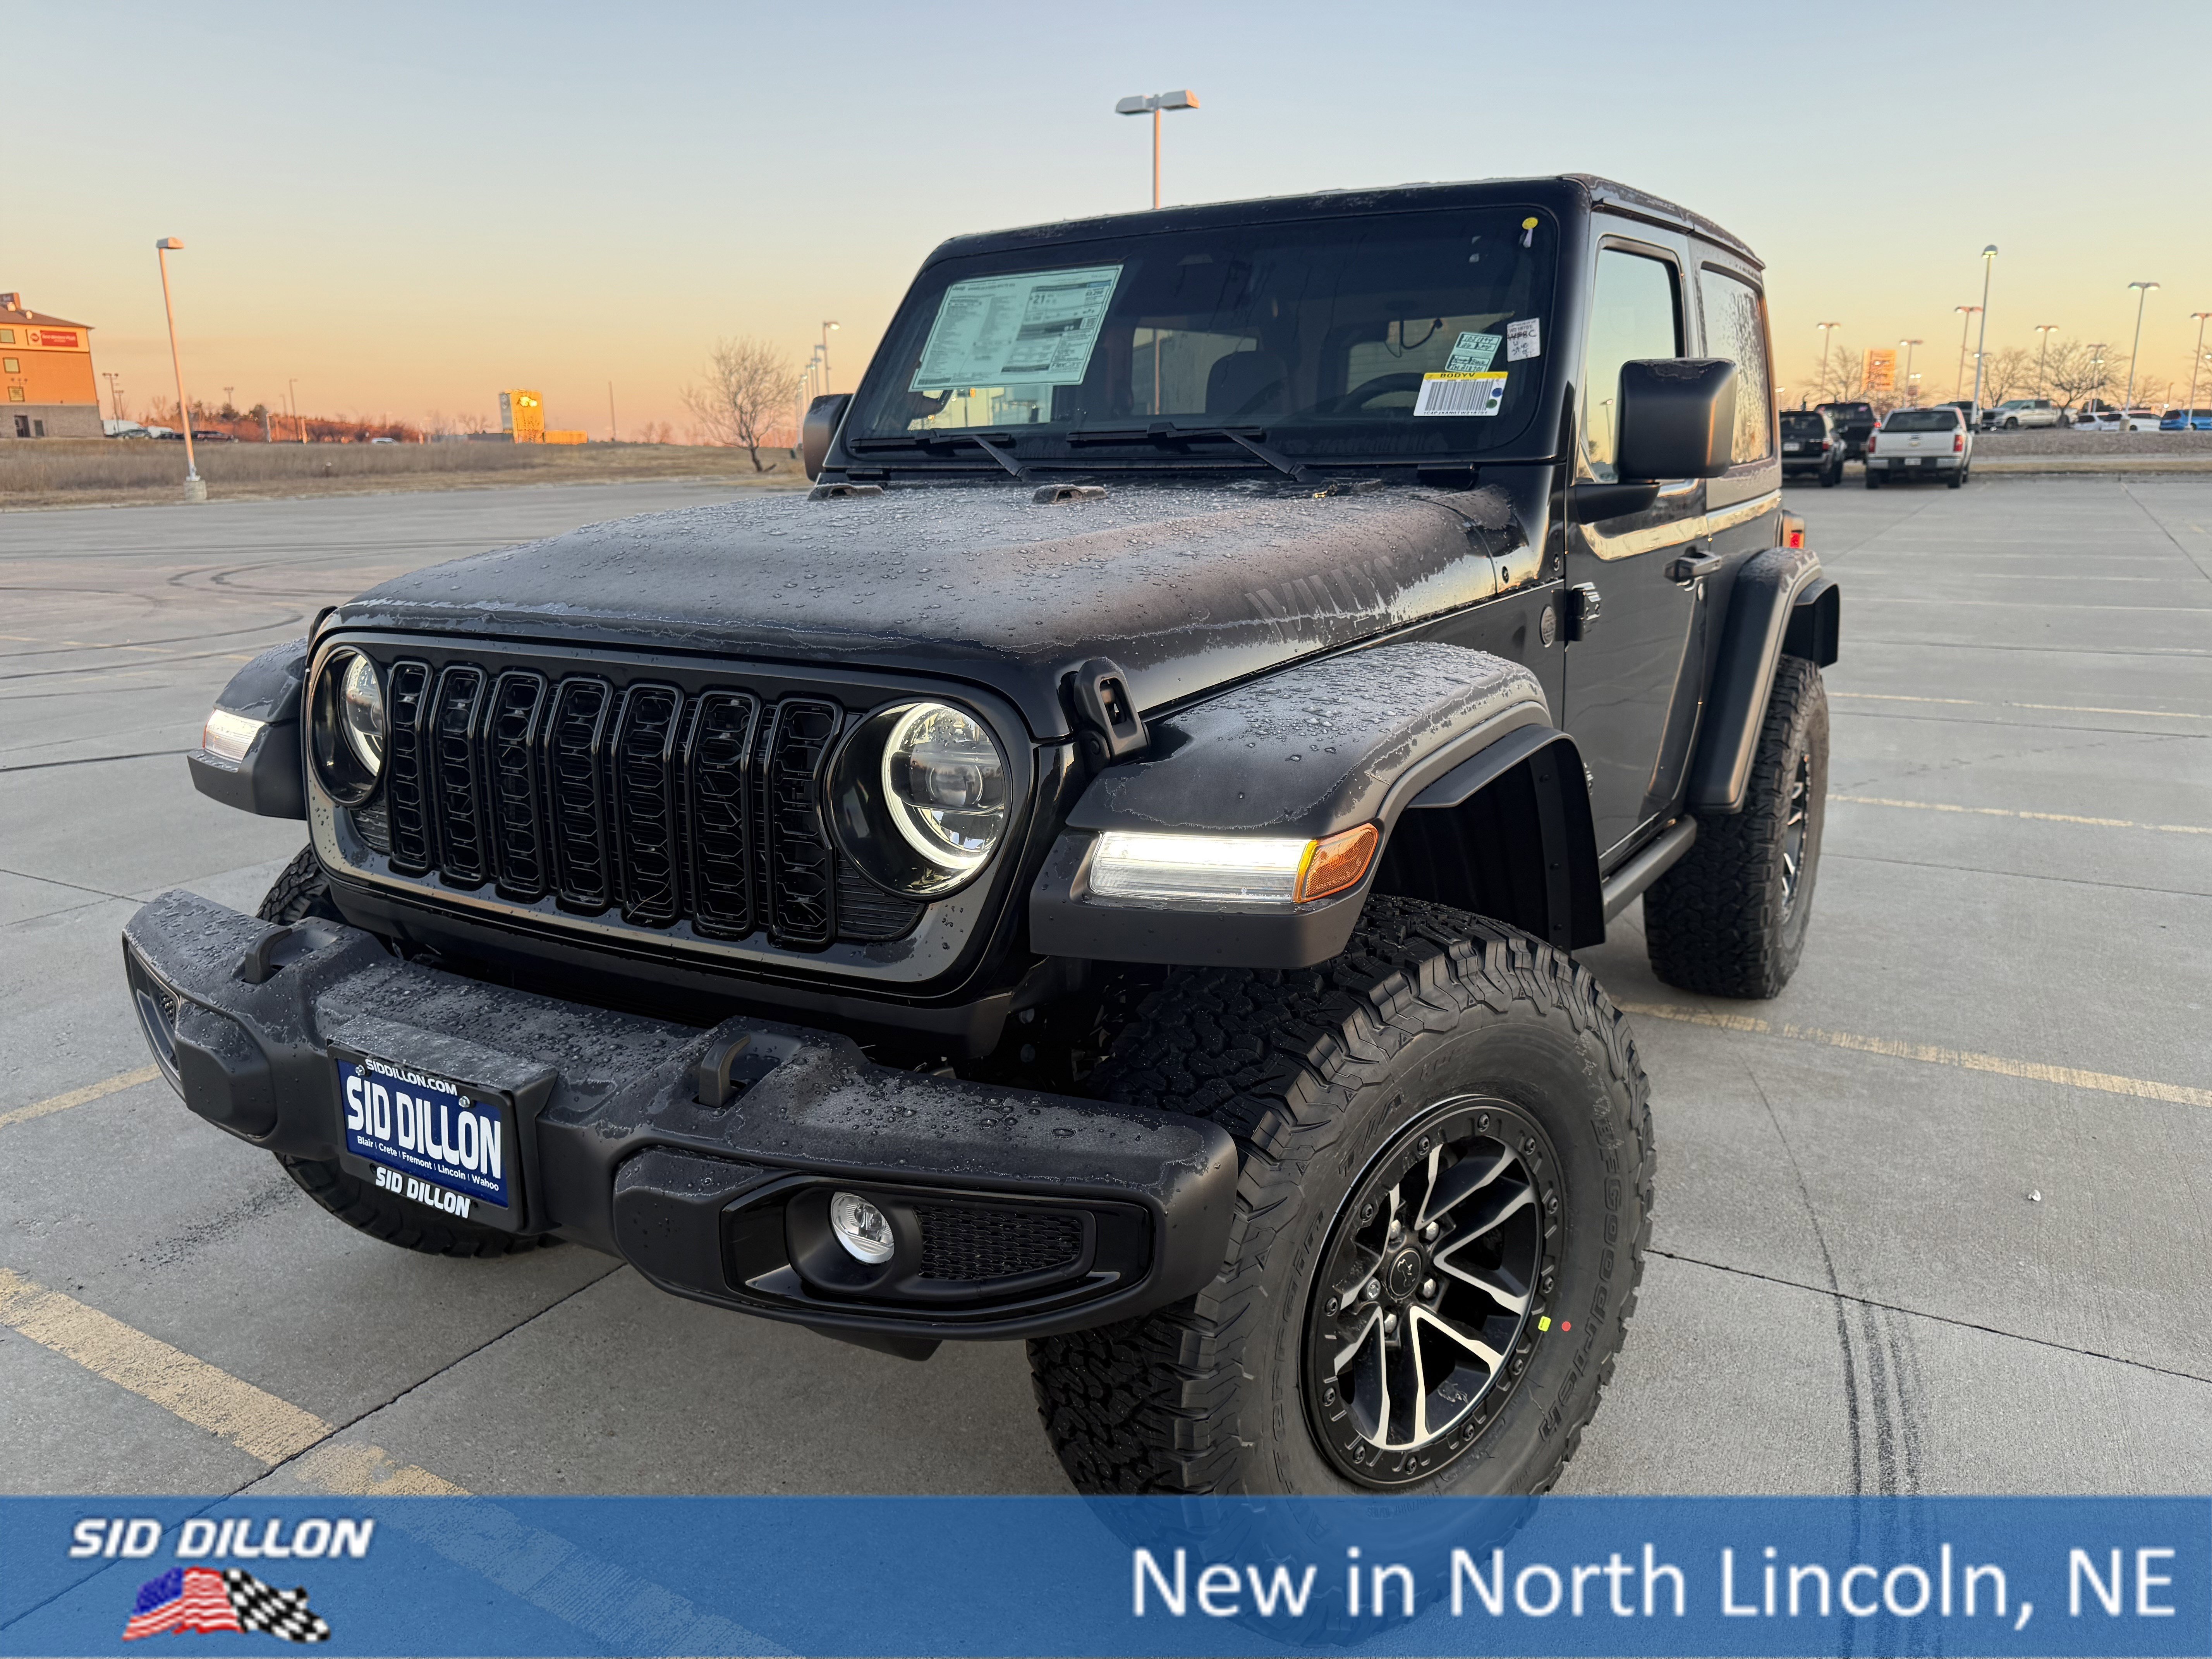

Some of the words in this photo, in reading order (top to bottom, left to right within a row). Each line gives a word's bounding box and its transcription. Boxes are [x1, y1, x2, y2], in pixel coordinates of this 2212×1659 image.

[1033, 295, 1046, 304] 21
[365, 1058, 458, 1096] SIDDILLON.COM
[346, 1075, 391, 1141] SID
[396, 1092, 501, 1179] DILLON
[357, 1135, 374, 1148] Blair
[378, 1143, 397, 1157] Crete
[402, 1152, 433, 1170] Fremont
[438, 1164, 466, 1181] Lincoln
[471, 1173, 500, 1192] Wahoo
[375, 1166, 403, 1194] SID
[406, 1178, 471, 1219] DILLON
